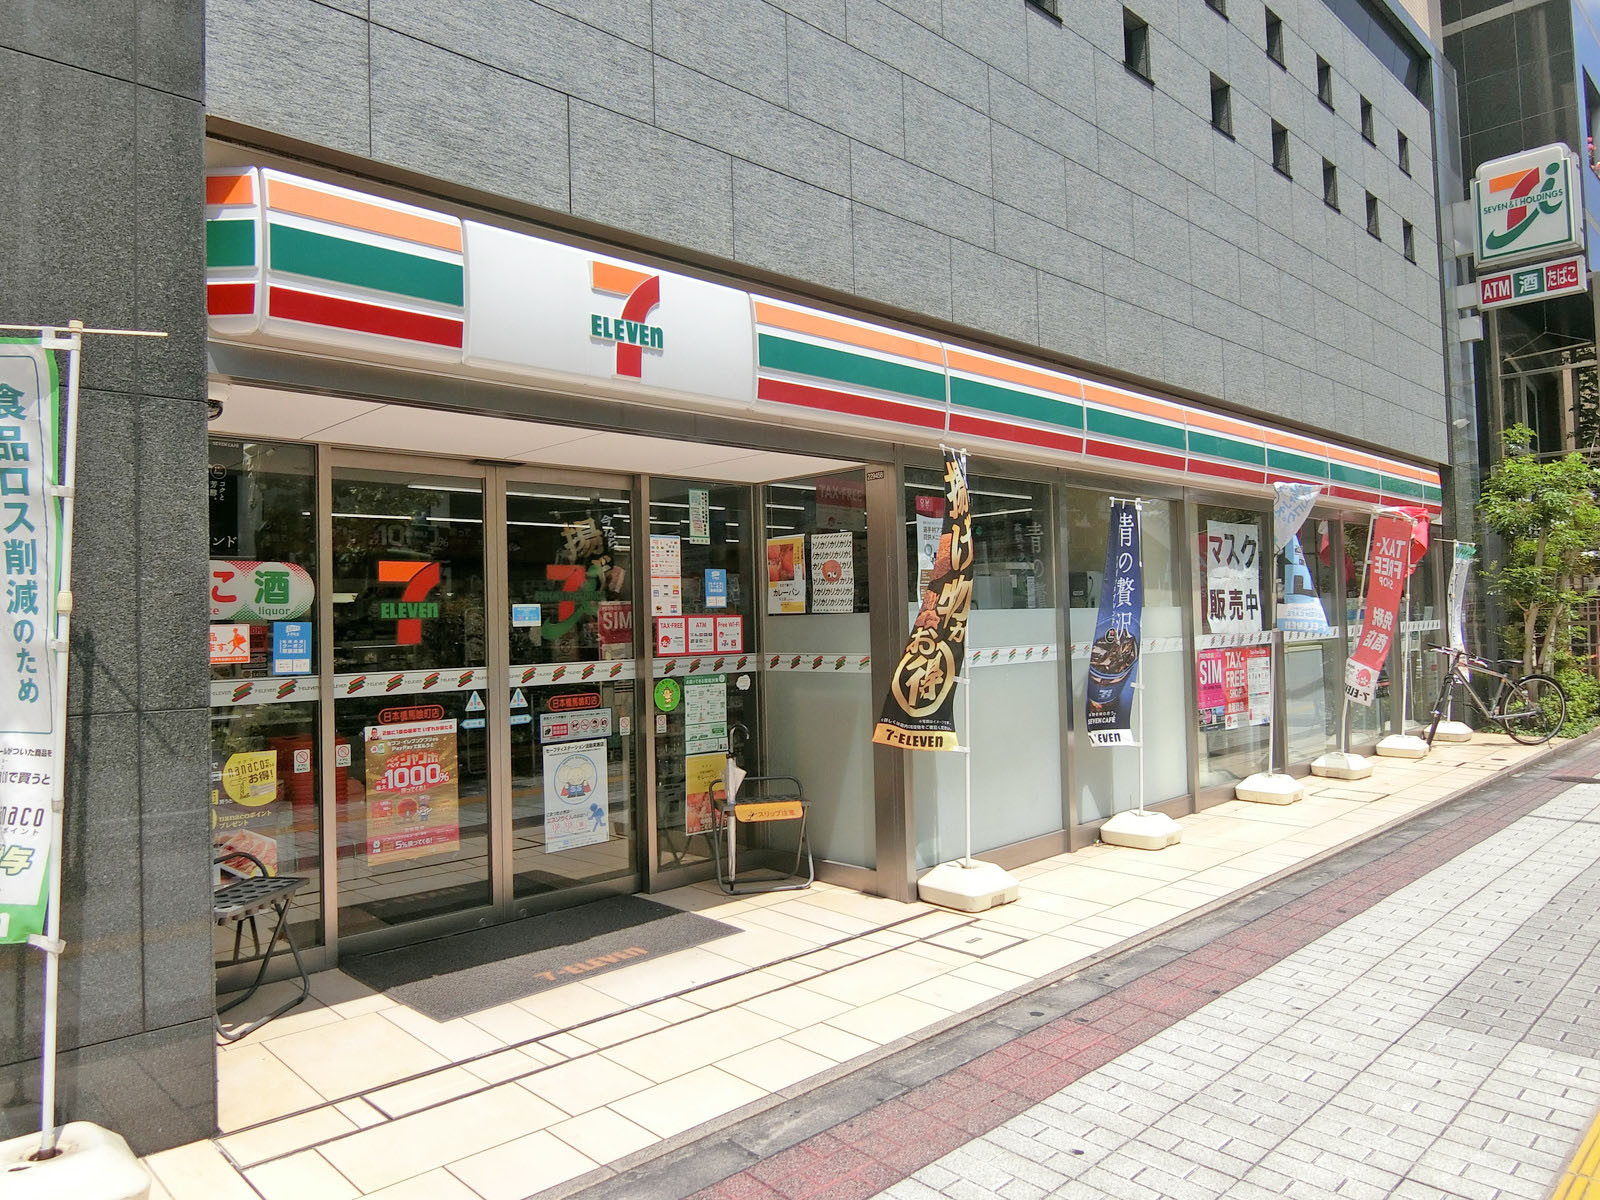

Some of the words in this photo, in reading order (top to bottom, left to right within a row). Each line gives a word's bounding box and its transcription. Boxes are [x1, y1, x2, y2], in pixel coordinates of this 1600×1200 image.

[1520, 188, 1564, 205] HOLDINGS
[1519, 272, 1538, 294] 酒
[1546, 266, 1577, 288] たばこ
[1483, 279, 1511, 301] ATM
[592, 261, 660, 378] 7
[1208, 533, 1257, 569] マスク
[254, 570, 290, 604] 酒
[1116, 512, 1135, 641] 青の贅沢
[379, 561, 440, 645] 7
[773, 587, 800, 597] カレーパン
[258, 606, 291, 616] liquor
[1209, 588, 1259, 621] 販売中
[603, 612, 632, 630] SIM
[1199, 659, 1223, 685] SIM
[1225, 670, 1245, 688] FREE
[227, 760, 265, 778] nanaco
